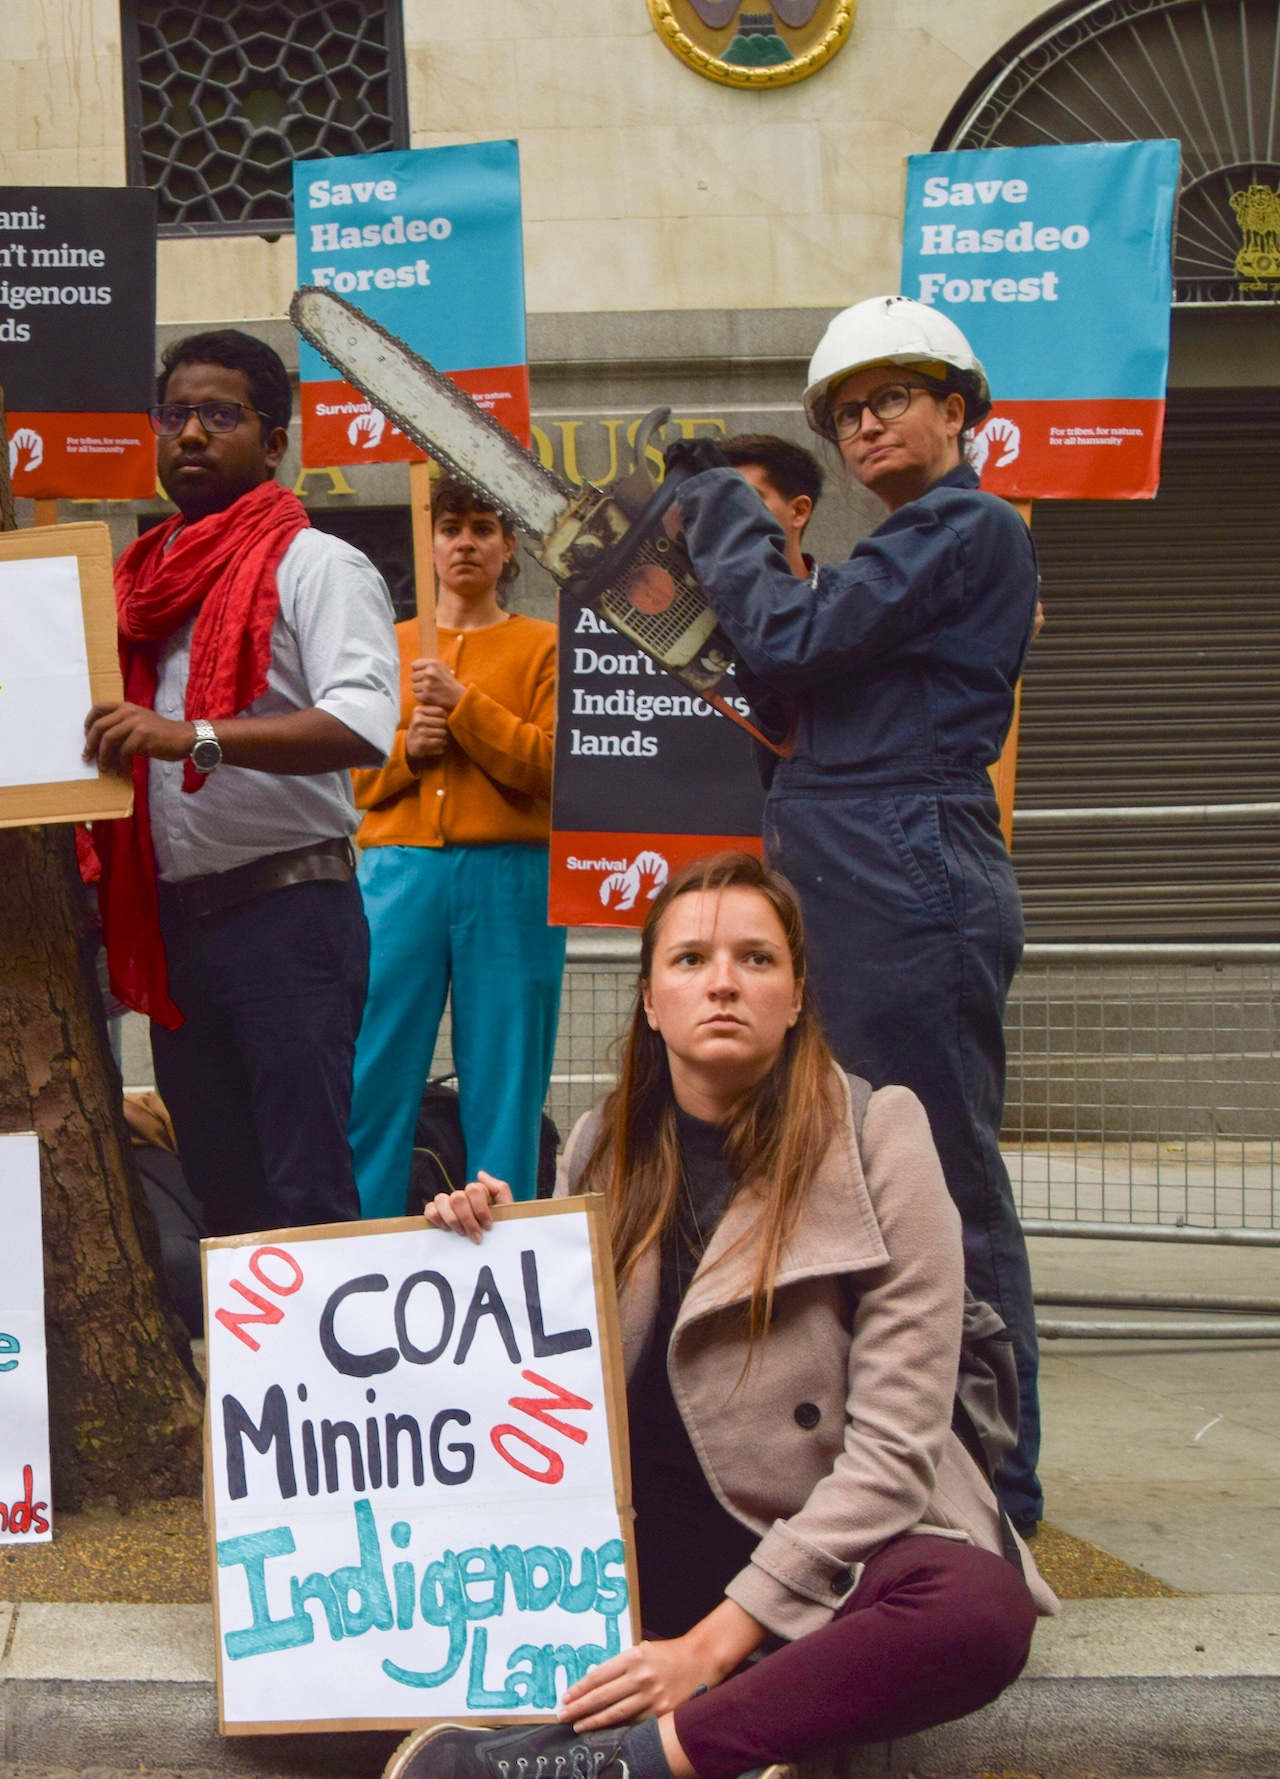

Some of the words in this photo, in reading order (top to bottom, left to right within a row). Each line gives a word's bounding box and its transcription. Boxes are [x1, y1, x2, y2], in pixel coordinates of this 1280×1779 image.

[309, 179, 398, 209] Save
[923, 176, 1029, 208] Save
[310, 216, 452, 252] Hasdeo
[920, 221, 1091, 255] Hasdeo
[31, 243, 106, 268] mine
[311, 259, 431, 293] Forest
[917, 271, 1060, 305] Forest
[315, 401, 372, 417] Survival
[1049, 427, 1065, 436] For
[1077, 436, 1123, 447] humanity
[570, 729, 658, 757] lands
[566, 855, 627, 871] Survival
[215, 1245, 304, 1353] NO
[319, 1249, 592, 1378] COAL
[216, 1498, 629, 1689] Indigenous
